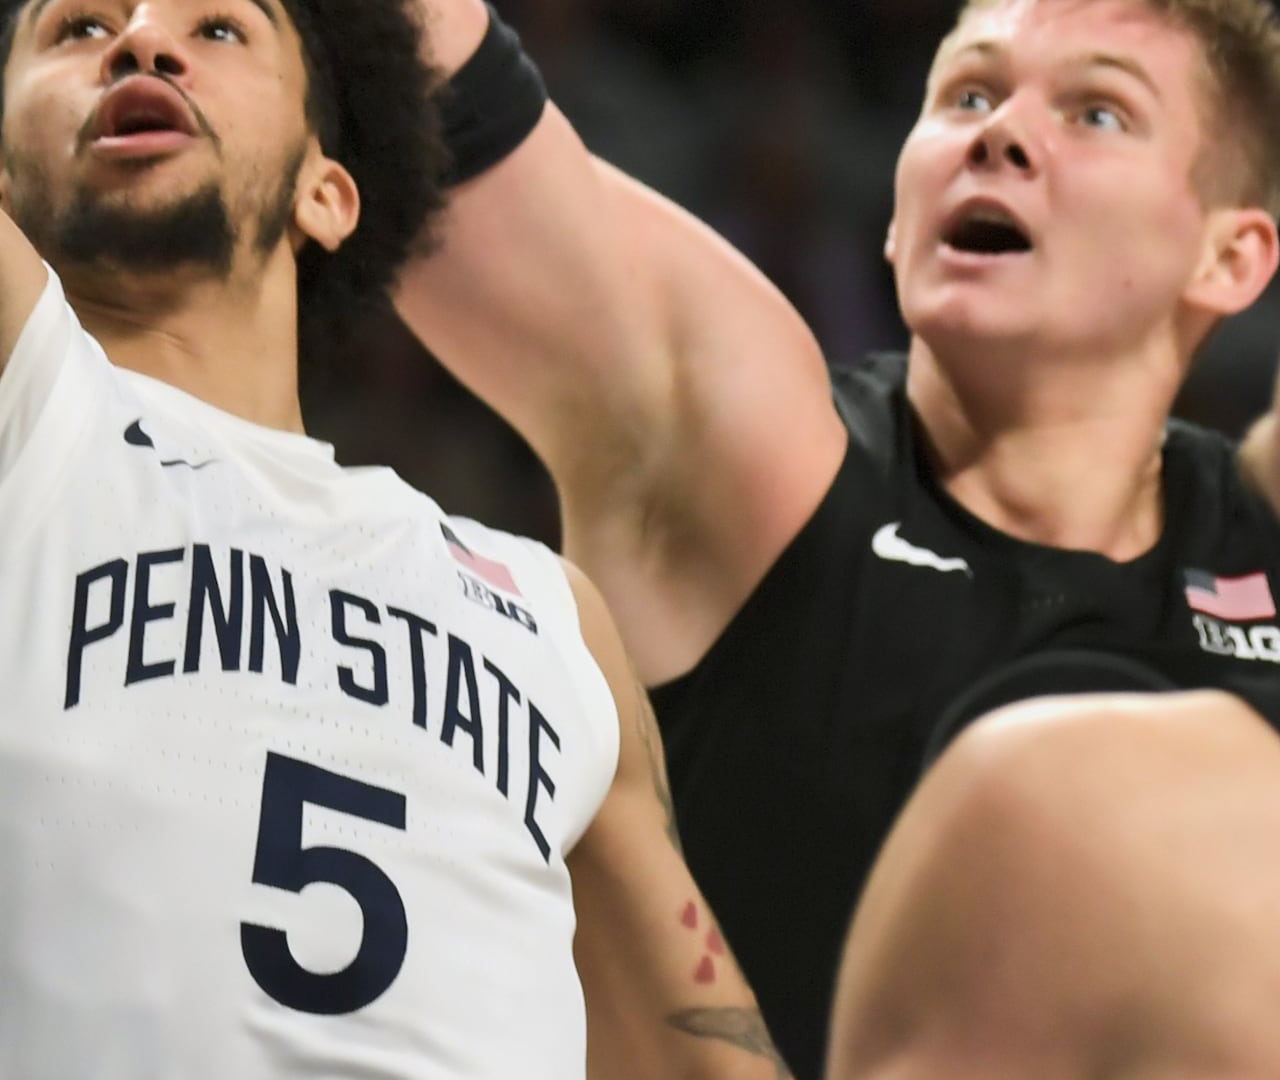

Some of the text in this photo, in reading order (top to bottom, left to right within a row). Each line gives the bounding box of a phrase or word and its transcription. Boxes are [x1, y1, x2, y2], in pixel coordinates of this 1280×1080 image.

[64, 542, 561, 863] PENN STATE
[240, 750, 408, 1016] 5
